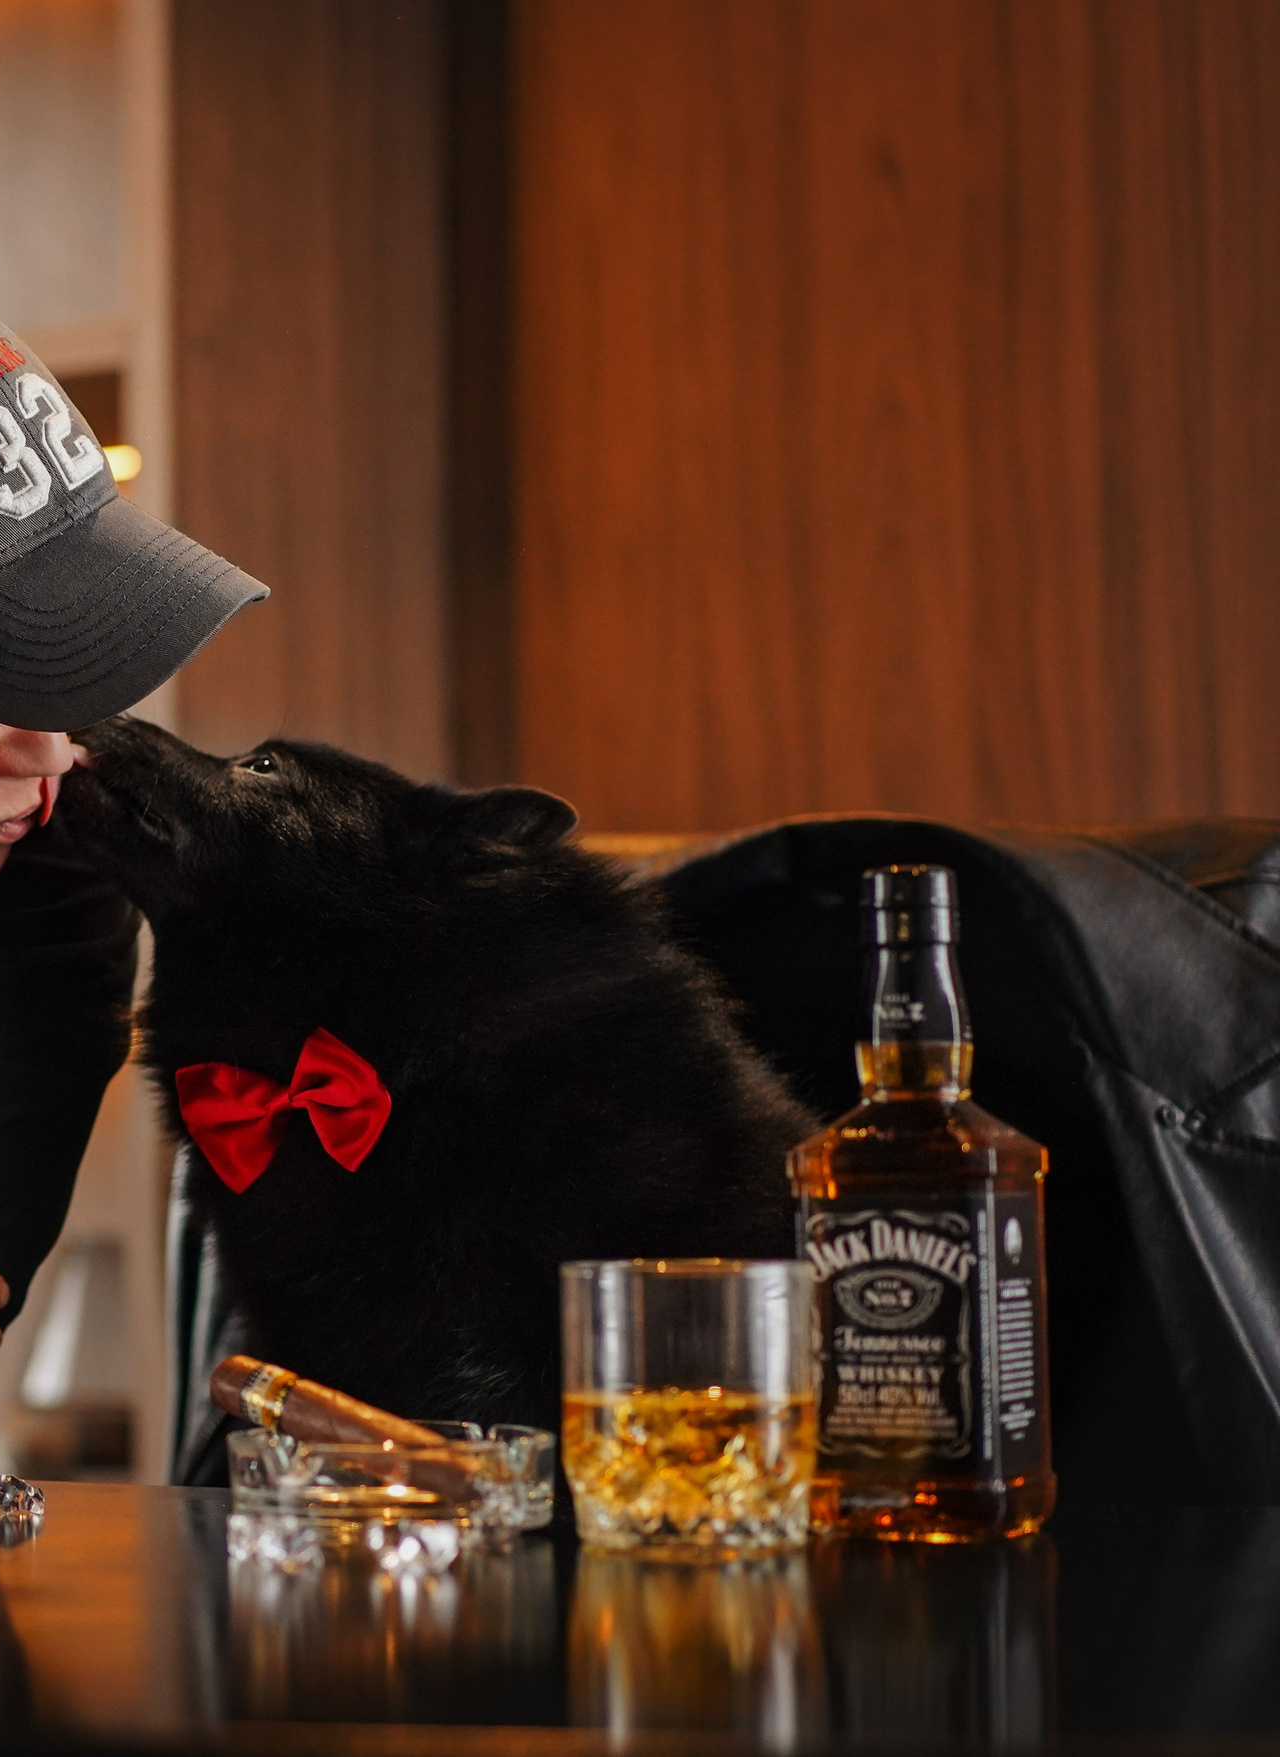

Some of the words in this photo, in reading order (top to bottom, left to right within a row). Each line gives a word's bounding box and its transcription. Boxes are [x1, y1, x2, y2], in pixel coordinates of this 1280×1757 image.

[805, 1229, 871, 1282] JACK
[870, 1218, 978, 1284] DANIEL'S
[837, 1364, 944, 1384] WHISKEY
